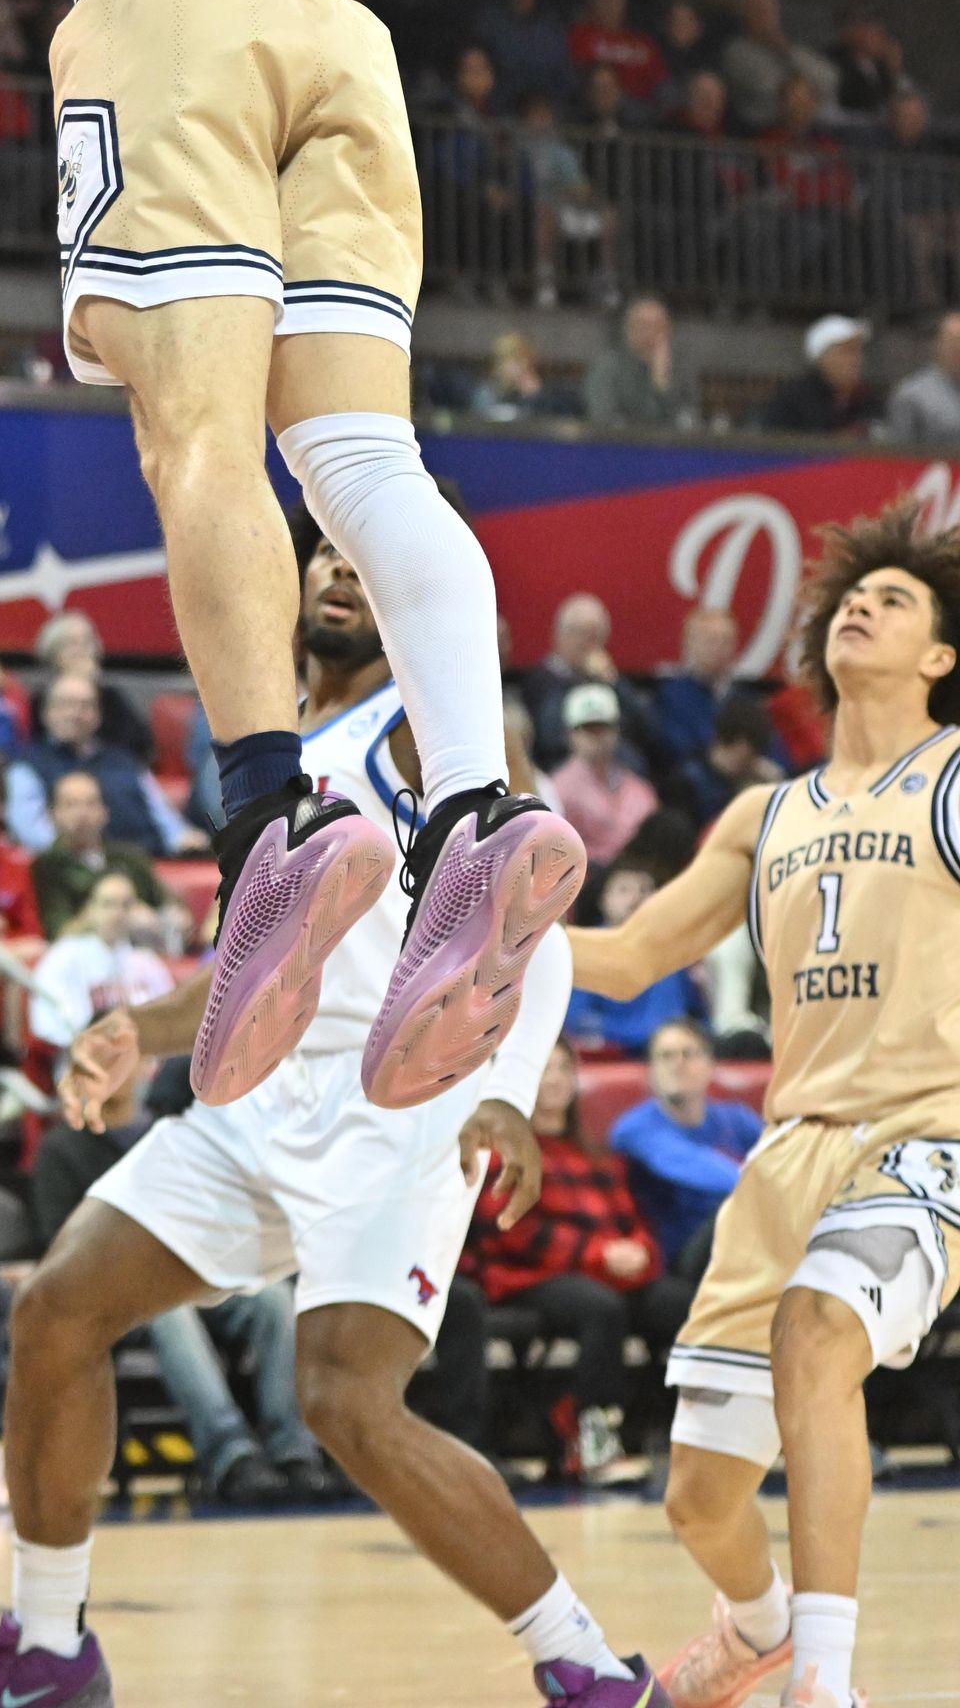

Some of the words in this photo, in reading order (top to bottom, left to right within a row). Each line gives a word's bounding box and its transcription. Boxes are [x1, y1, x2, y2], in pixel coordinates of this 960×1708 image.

[768, 830, 915, 892] GEORGIA
[816, 872, 843, 954] 1
[793, 959, 880, 1005] TECH
